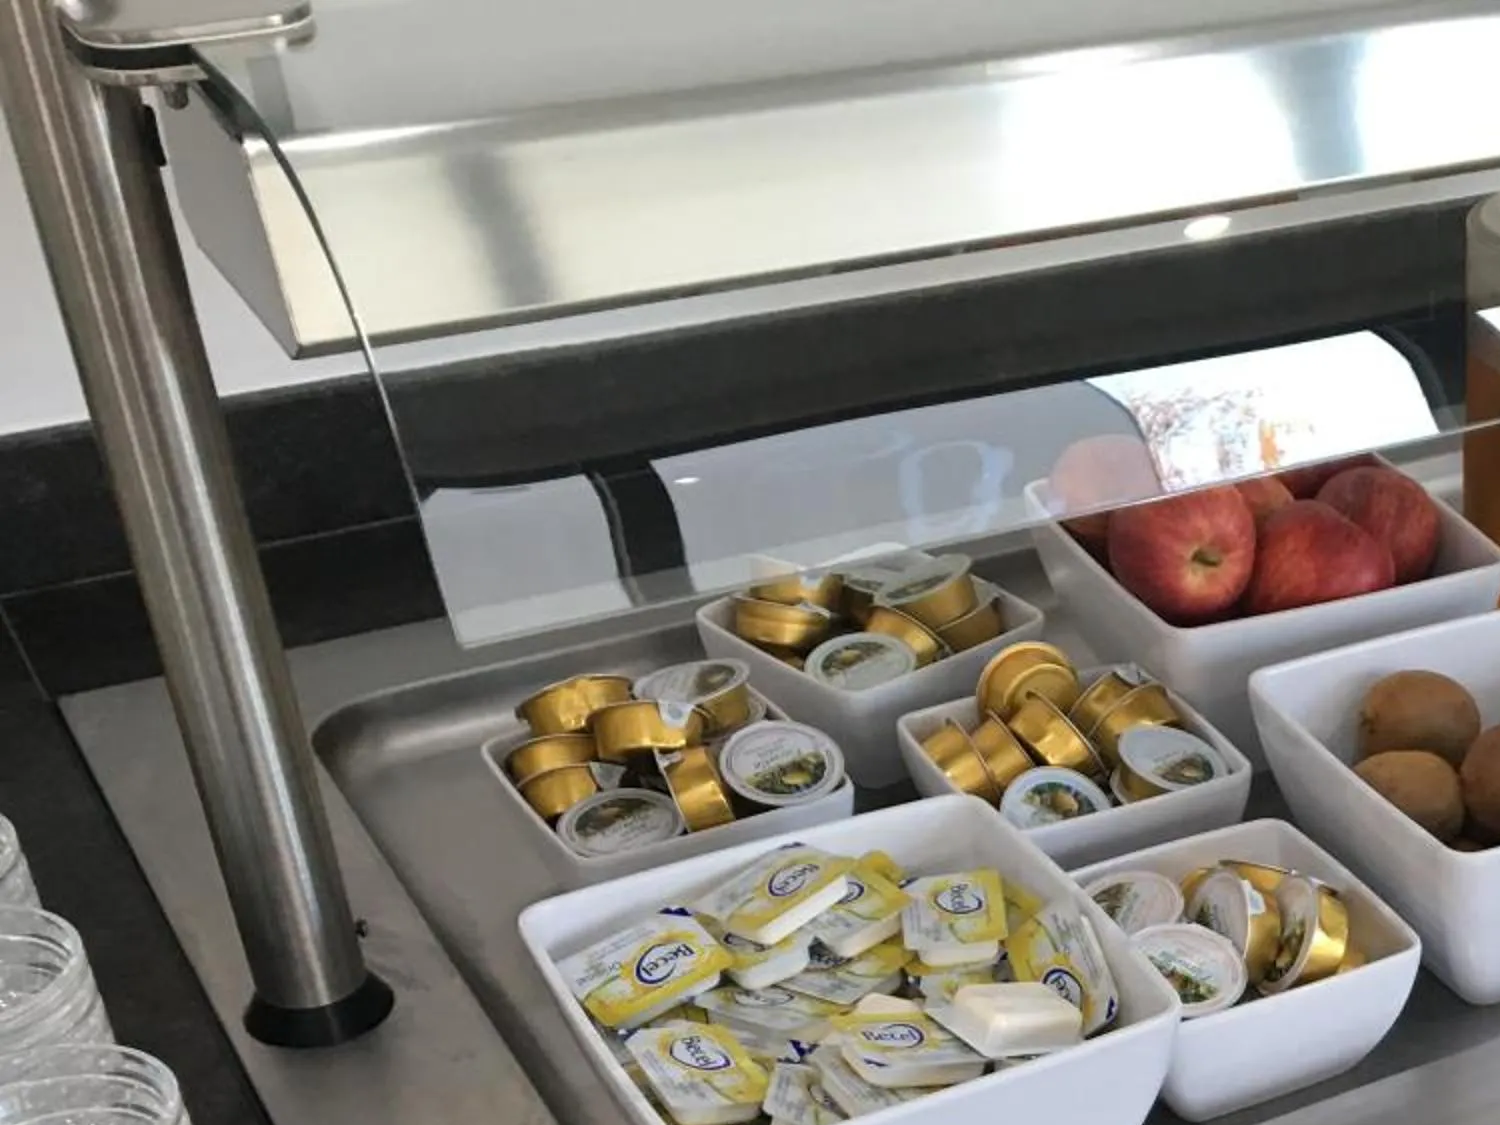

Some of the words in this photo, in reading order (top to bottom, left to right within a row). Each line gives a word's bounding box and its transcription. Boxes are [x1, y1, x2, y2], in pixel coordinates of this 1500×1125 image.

[950, 883, 972, 911] Becel
[641, 942, 695, 977] Becel
[861, 1028, 918, 1042] Becel
[681, 1035, 718, 1067] Becel
